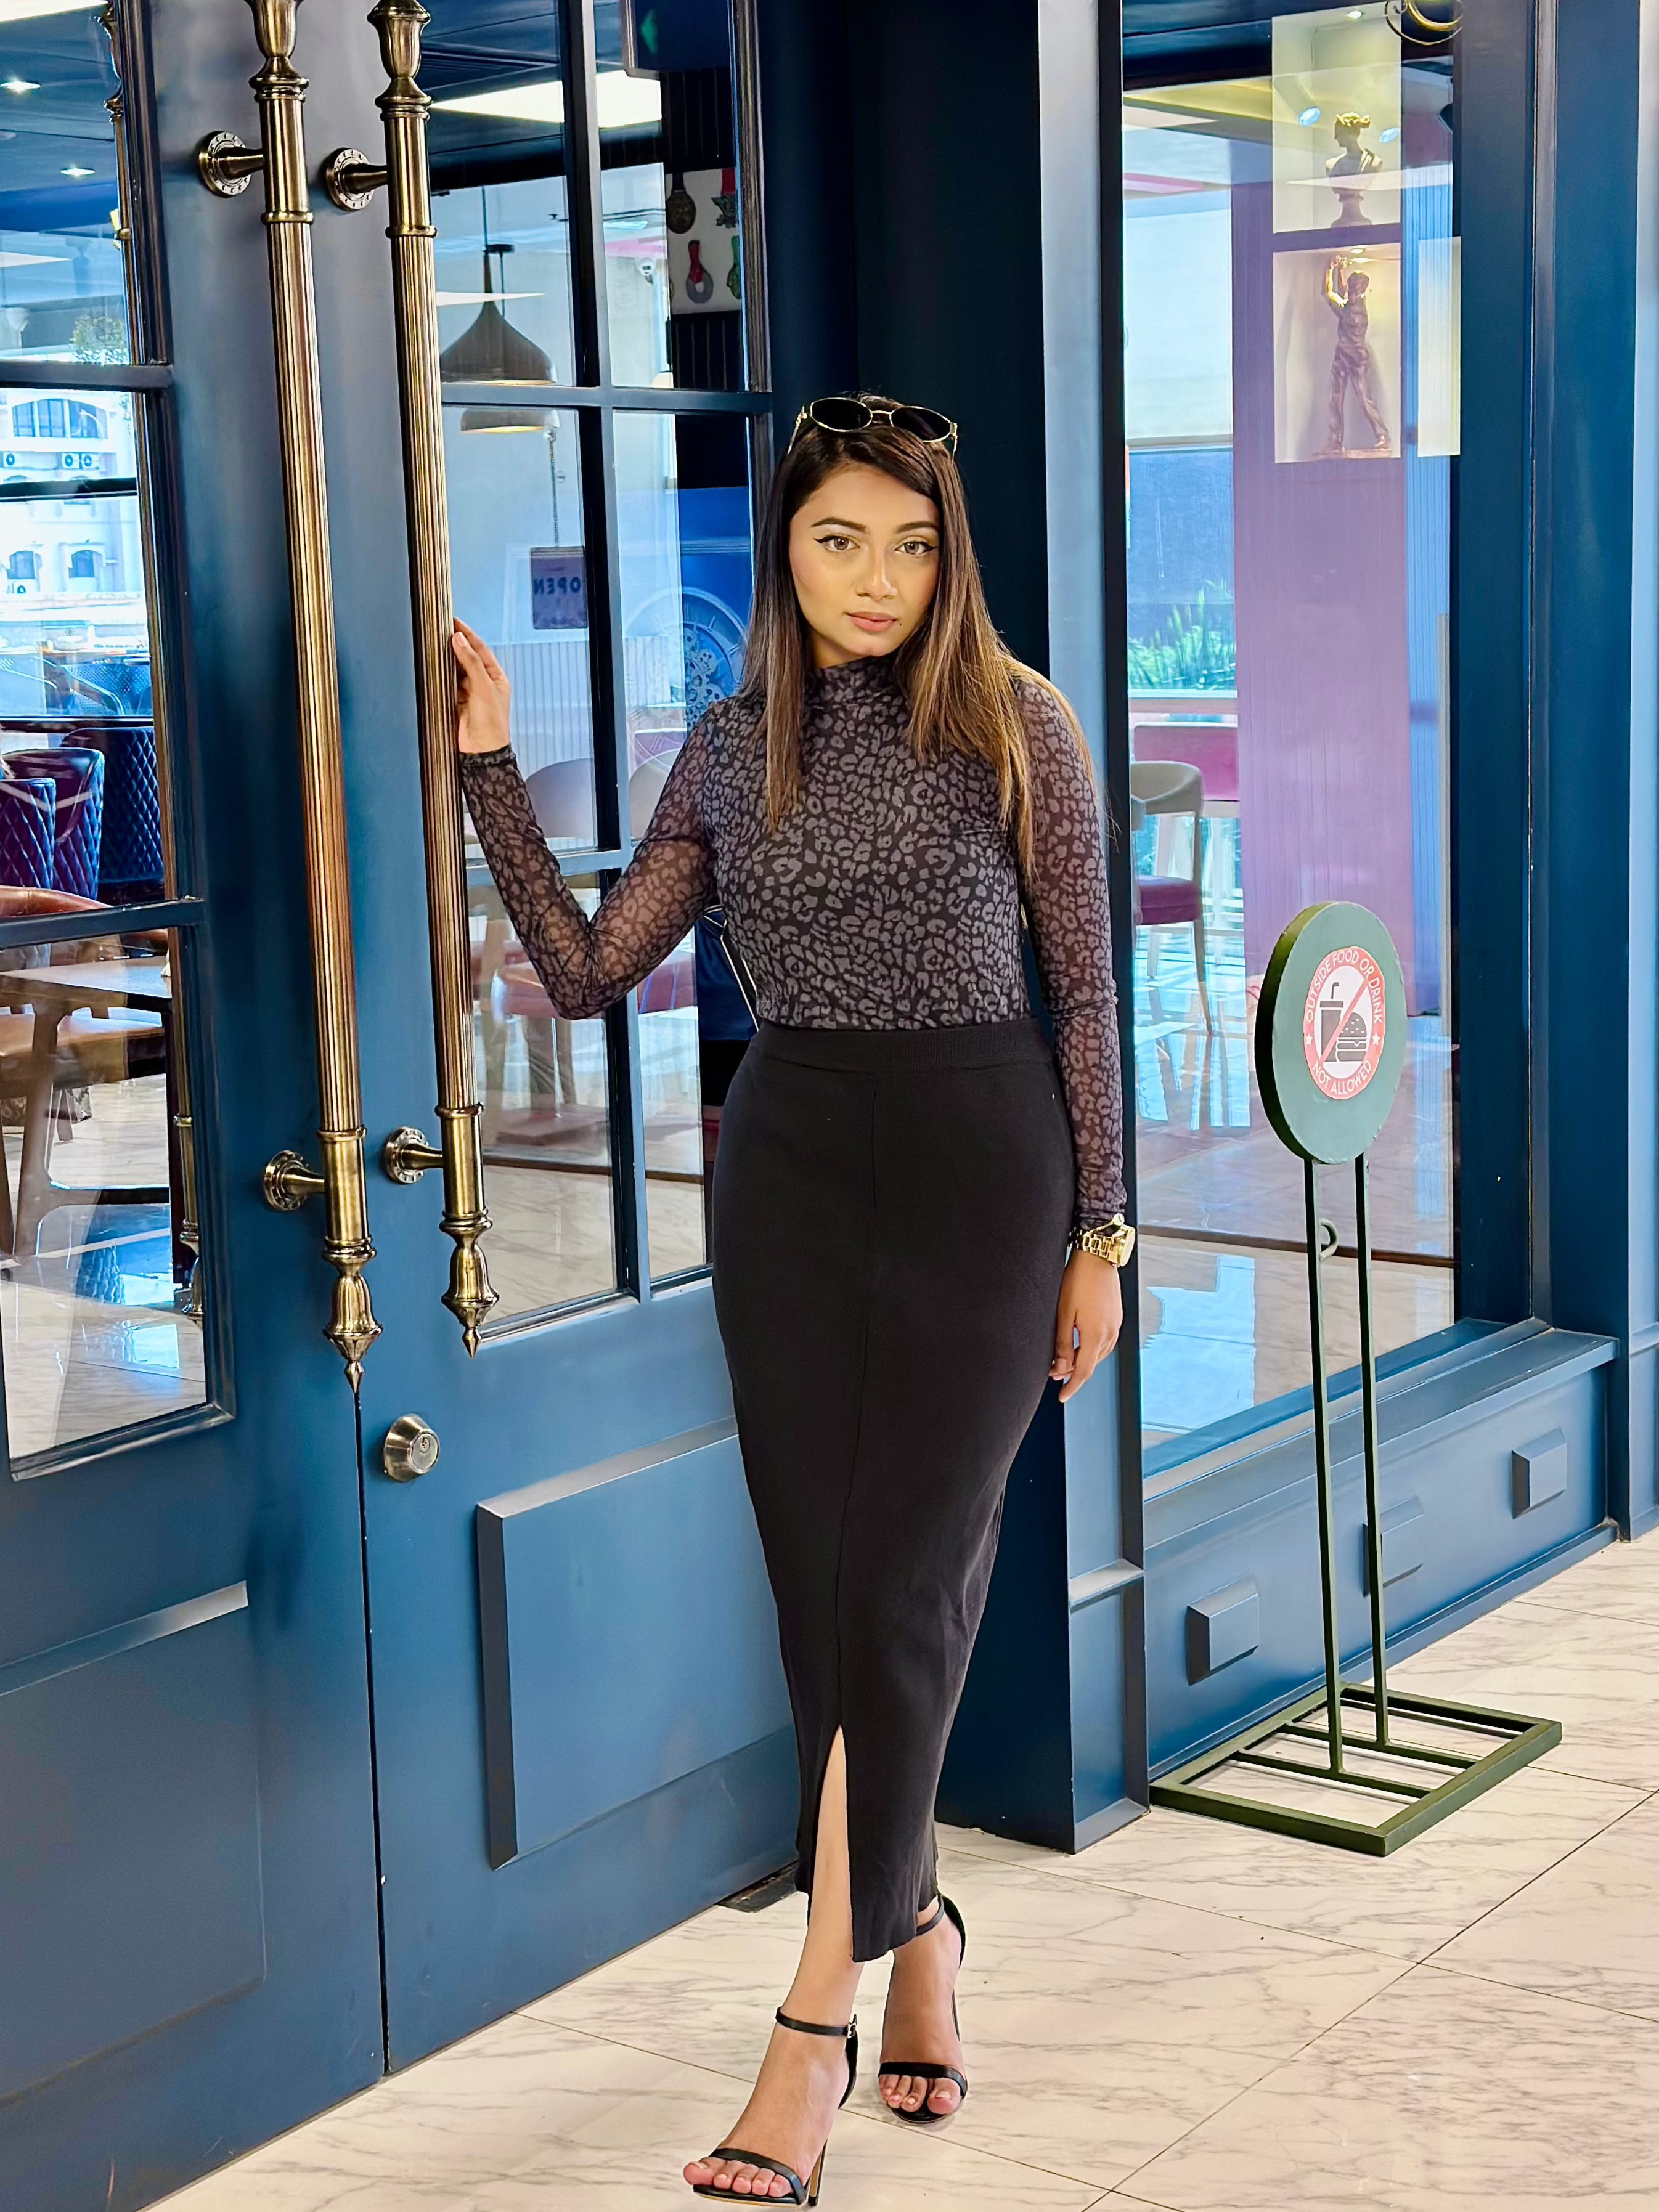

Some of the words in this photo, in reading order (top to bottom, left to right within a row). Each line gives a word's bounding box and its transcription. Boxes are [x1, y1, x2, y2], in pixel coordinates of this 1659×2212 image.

[1306, 961, 1331, 1023] OUTSIDE
[1332, 949, 1359, 966] FOOD
[1359, 958, 1374, 978] OR
[1368, 977, 1383, 1023] DRINK
[1313, 1060, 1331, 1089] NOT
[1331, 1060, 1371, 1095] ALLOWED
